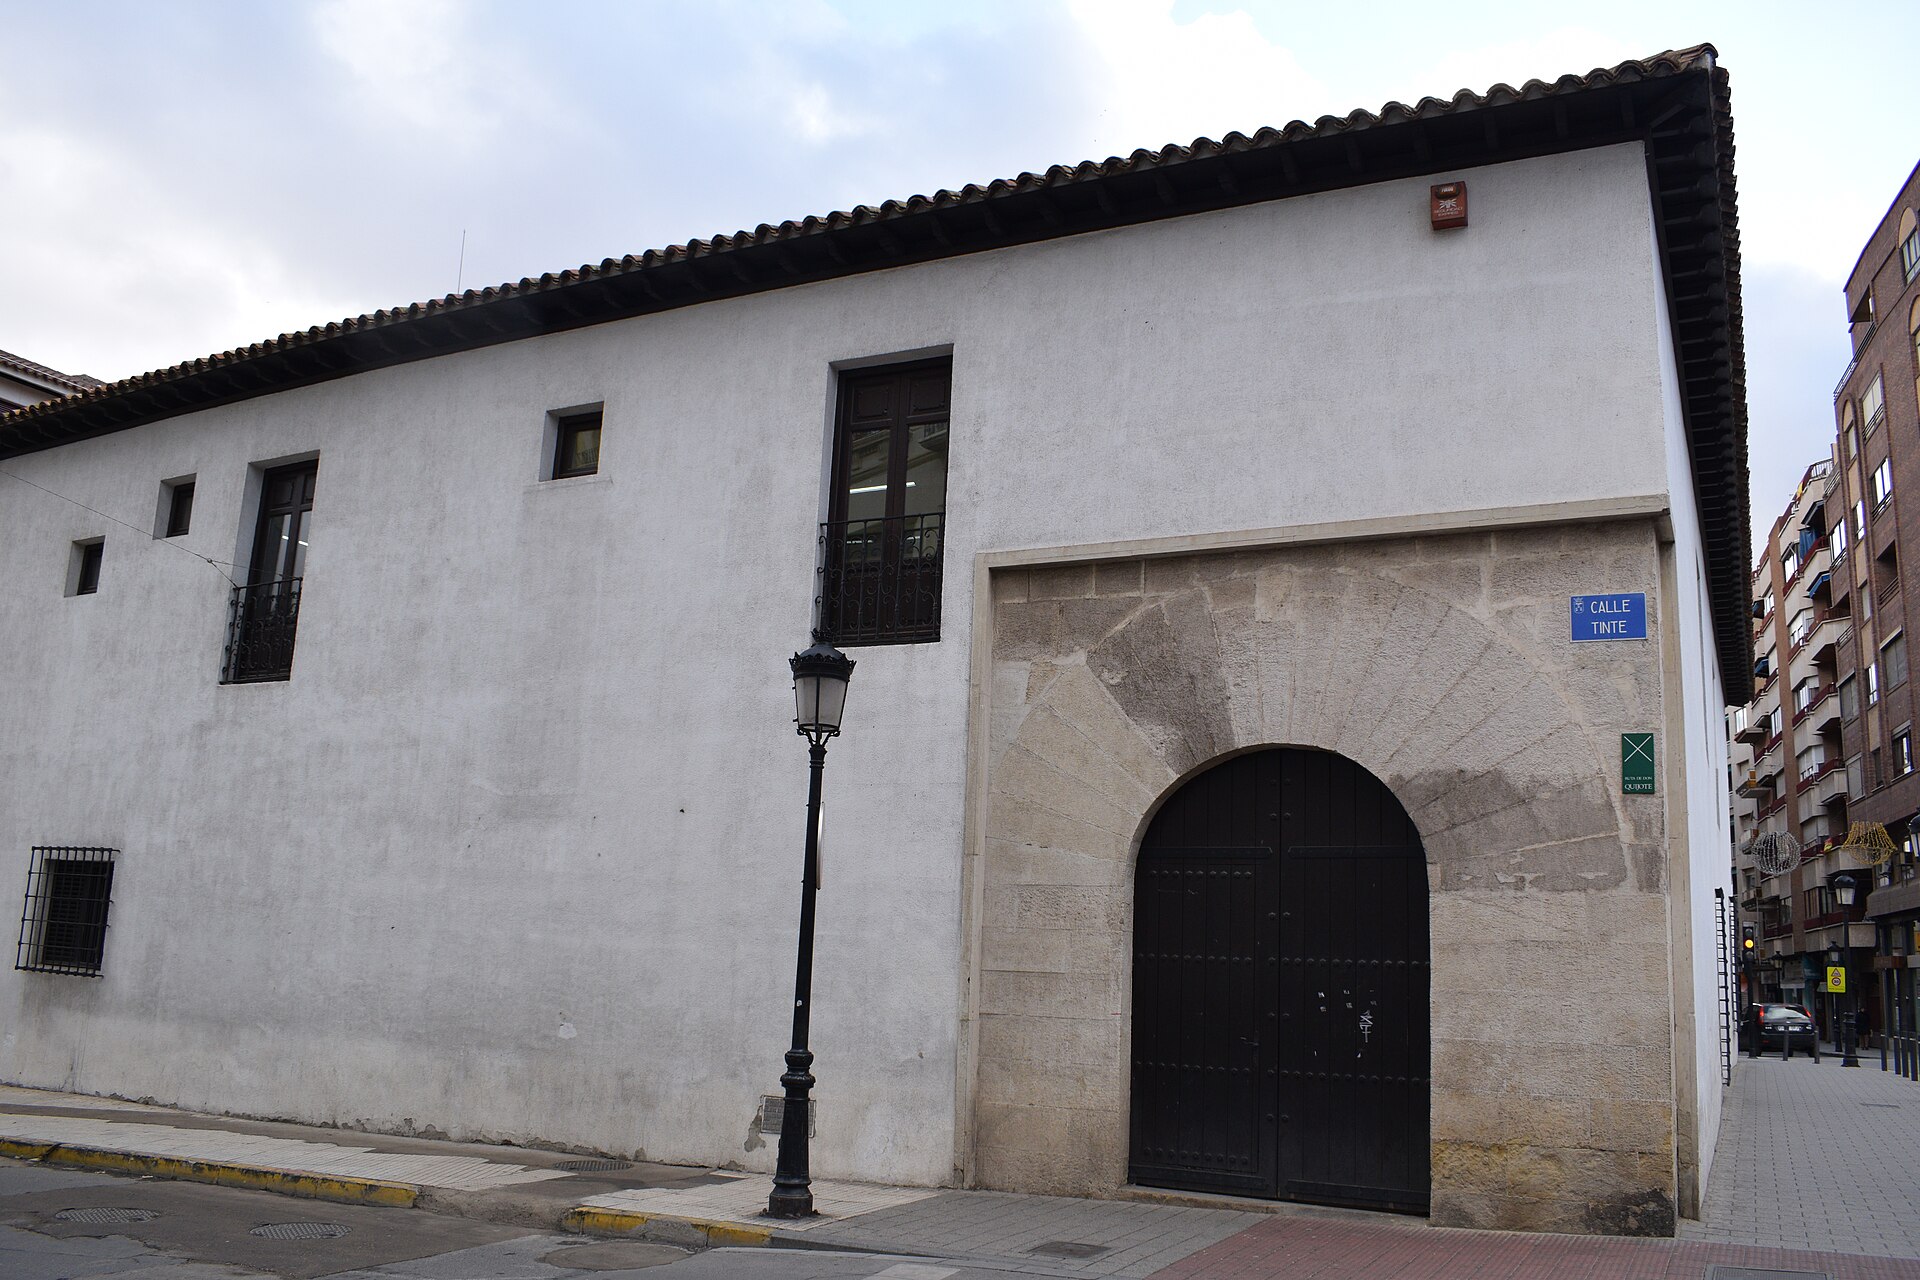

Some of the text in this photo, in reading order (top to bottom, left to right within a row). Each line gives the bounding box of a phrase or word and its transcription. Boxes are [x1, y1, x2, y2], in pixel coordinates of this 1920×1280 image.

[1590, 599, 1631, 613] CALLE
[1591, 620, 1627, 634] TINTE
[1624, 783, 1653, 791] QUIJOTE
